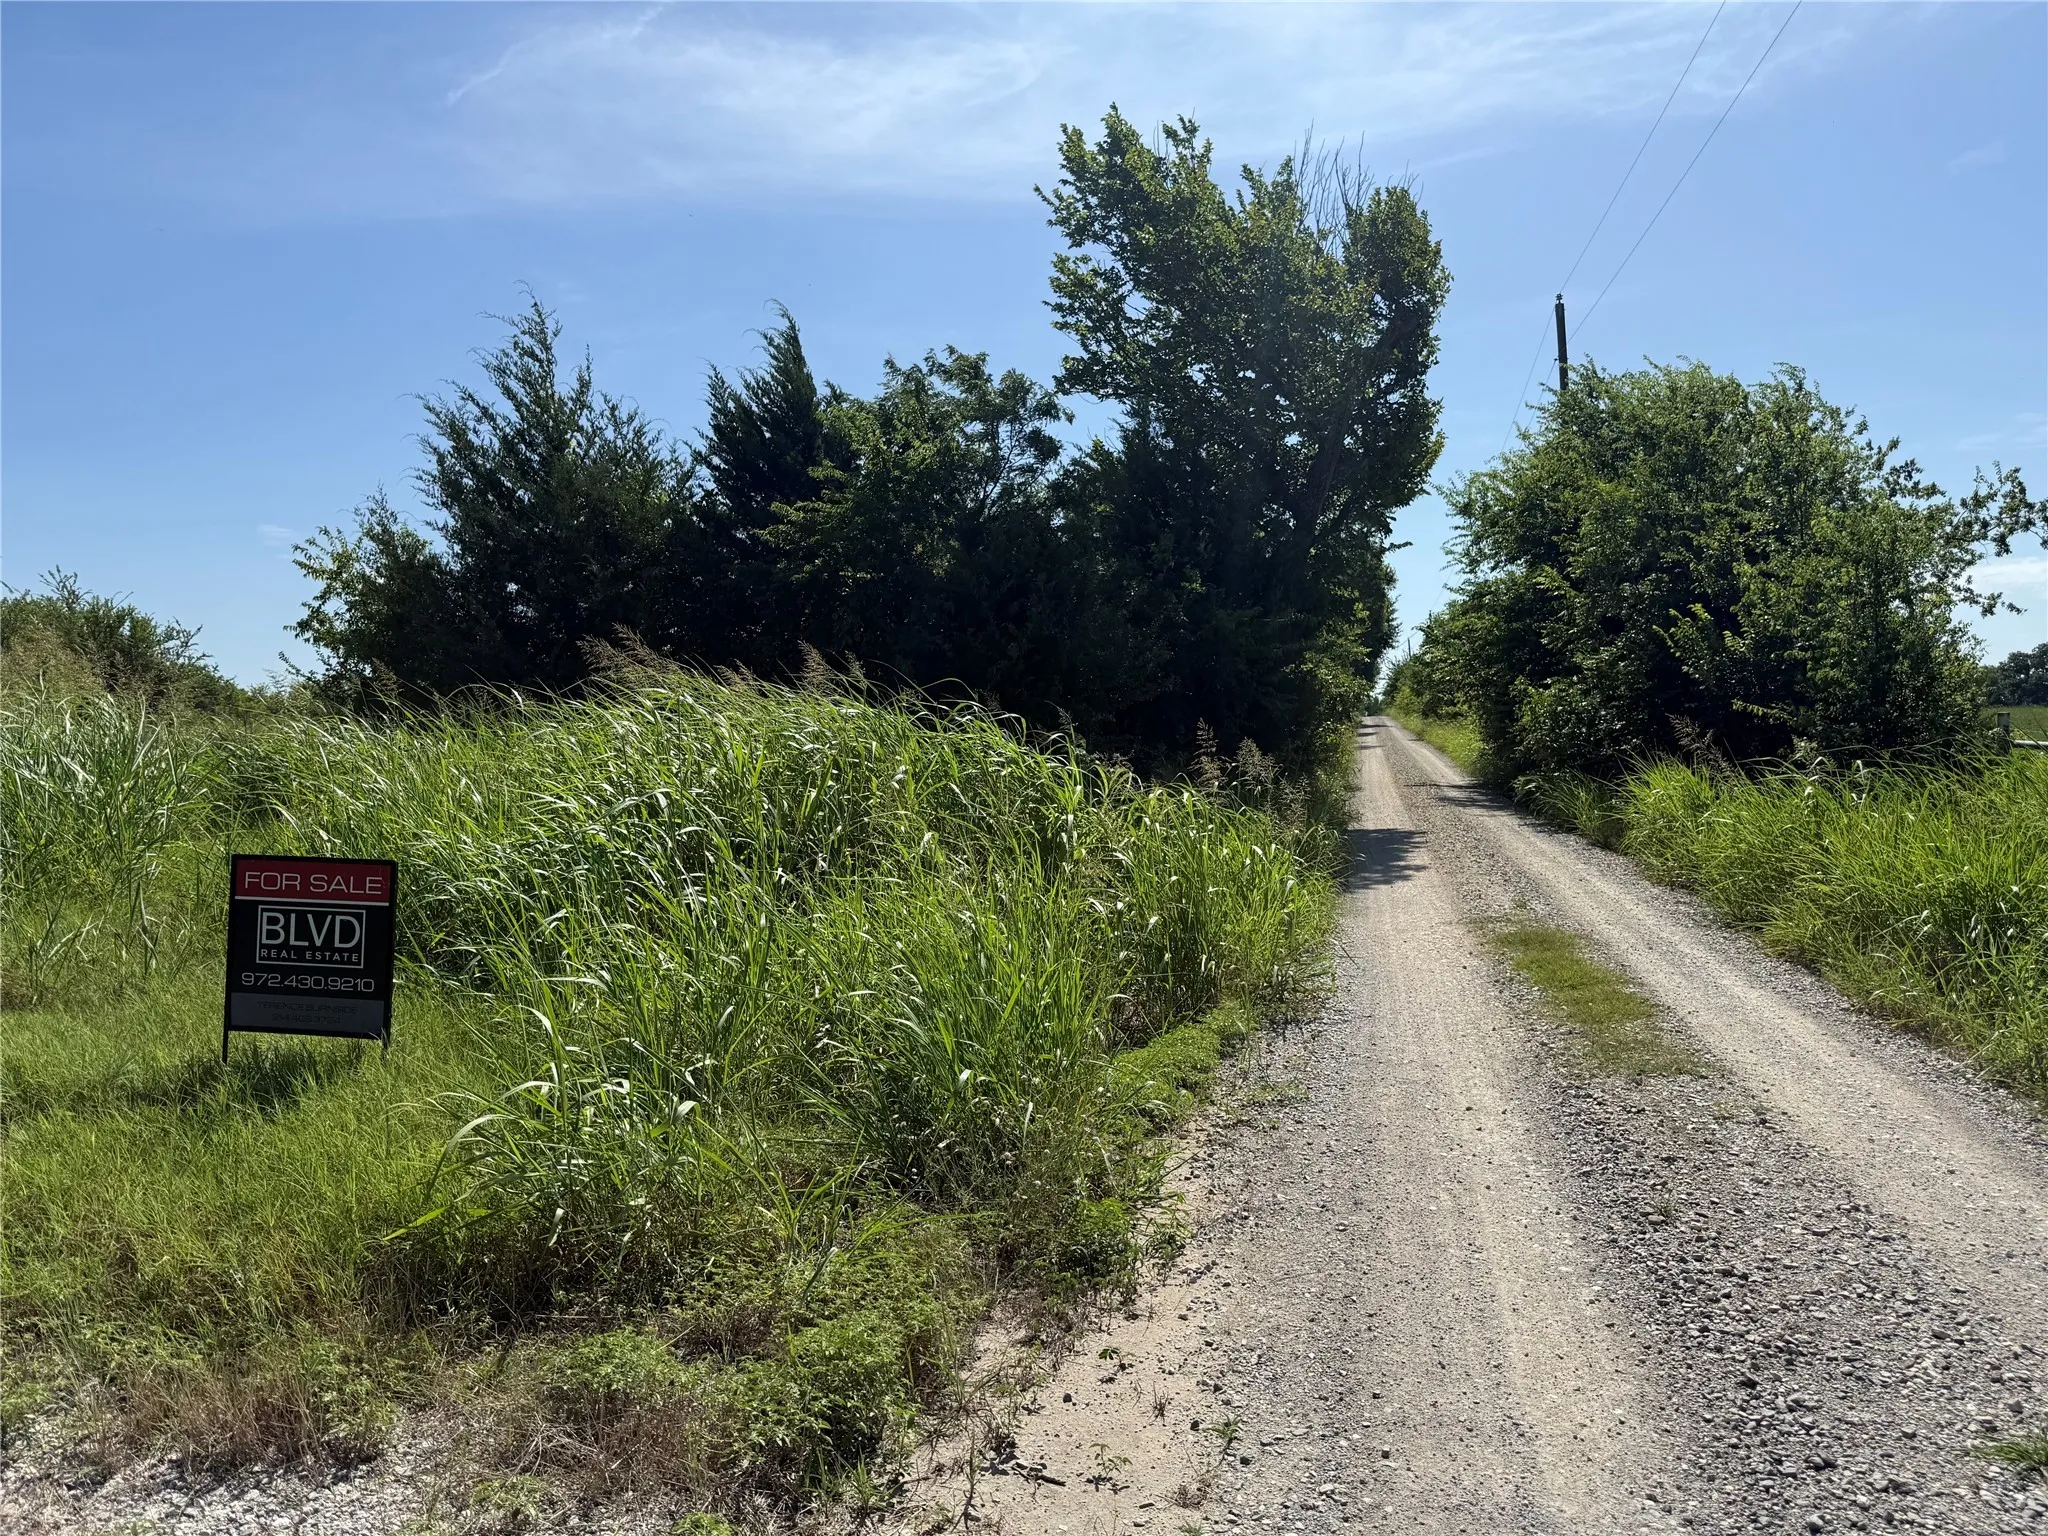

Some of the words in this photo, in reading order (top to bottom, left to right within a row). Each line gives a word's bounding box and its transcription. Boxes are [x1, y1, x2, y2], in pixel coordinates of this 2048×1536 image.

[244, 871, 301, 891] FOR
[309, 875, 383, 895] SALE
[261, 911, 361, 949] BLVD
[260, 949, 297, 959] REAL
[306, 951, 359, 962] ESTATE
[241, 972, 374, 993] 972.430.9210
